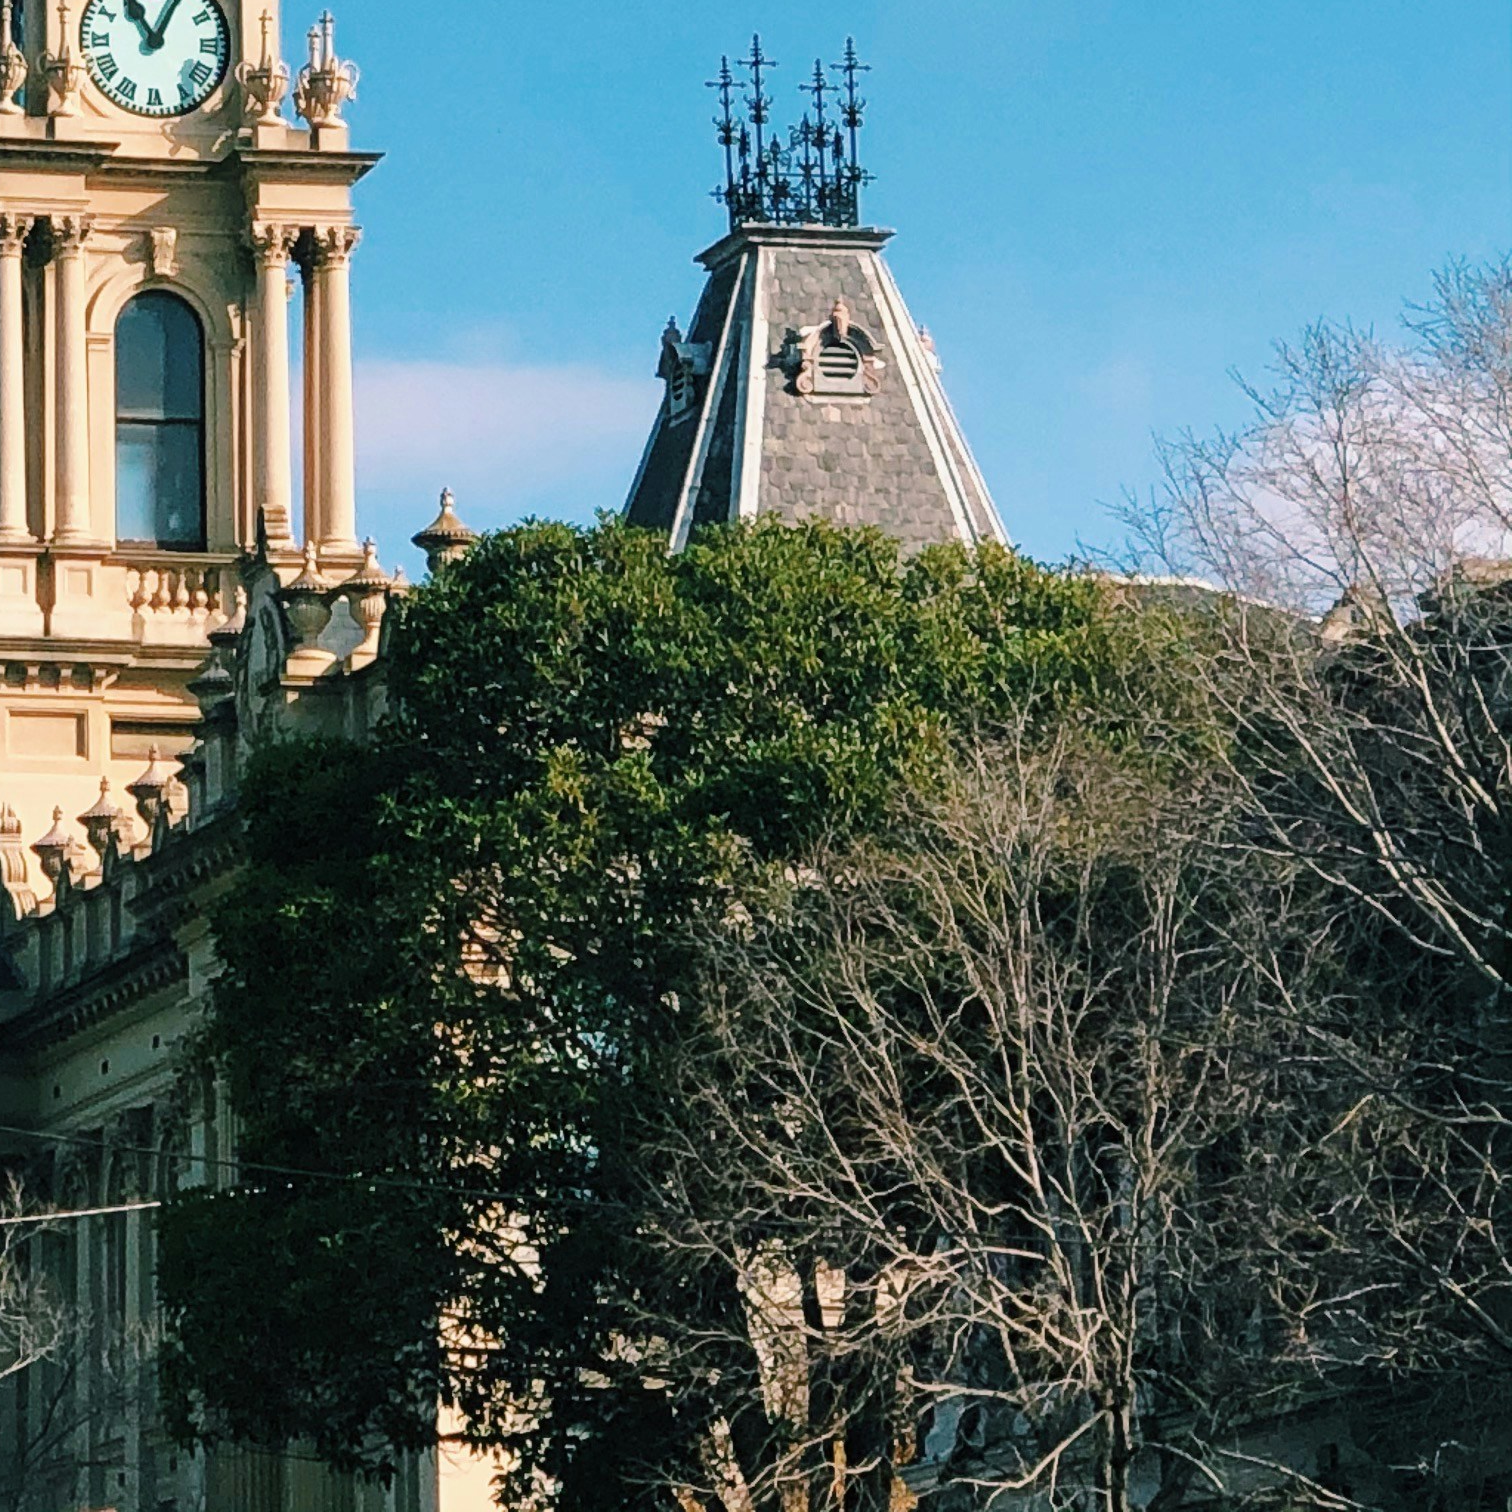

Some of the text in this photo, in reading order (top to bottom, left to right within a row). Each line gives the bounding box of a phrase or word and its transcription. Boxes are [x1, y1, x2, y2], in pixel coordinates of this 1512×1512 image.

[99, 8, 116, 23] X
[192, 10, 211, 26] II
[200, 38, 218, 55] III
